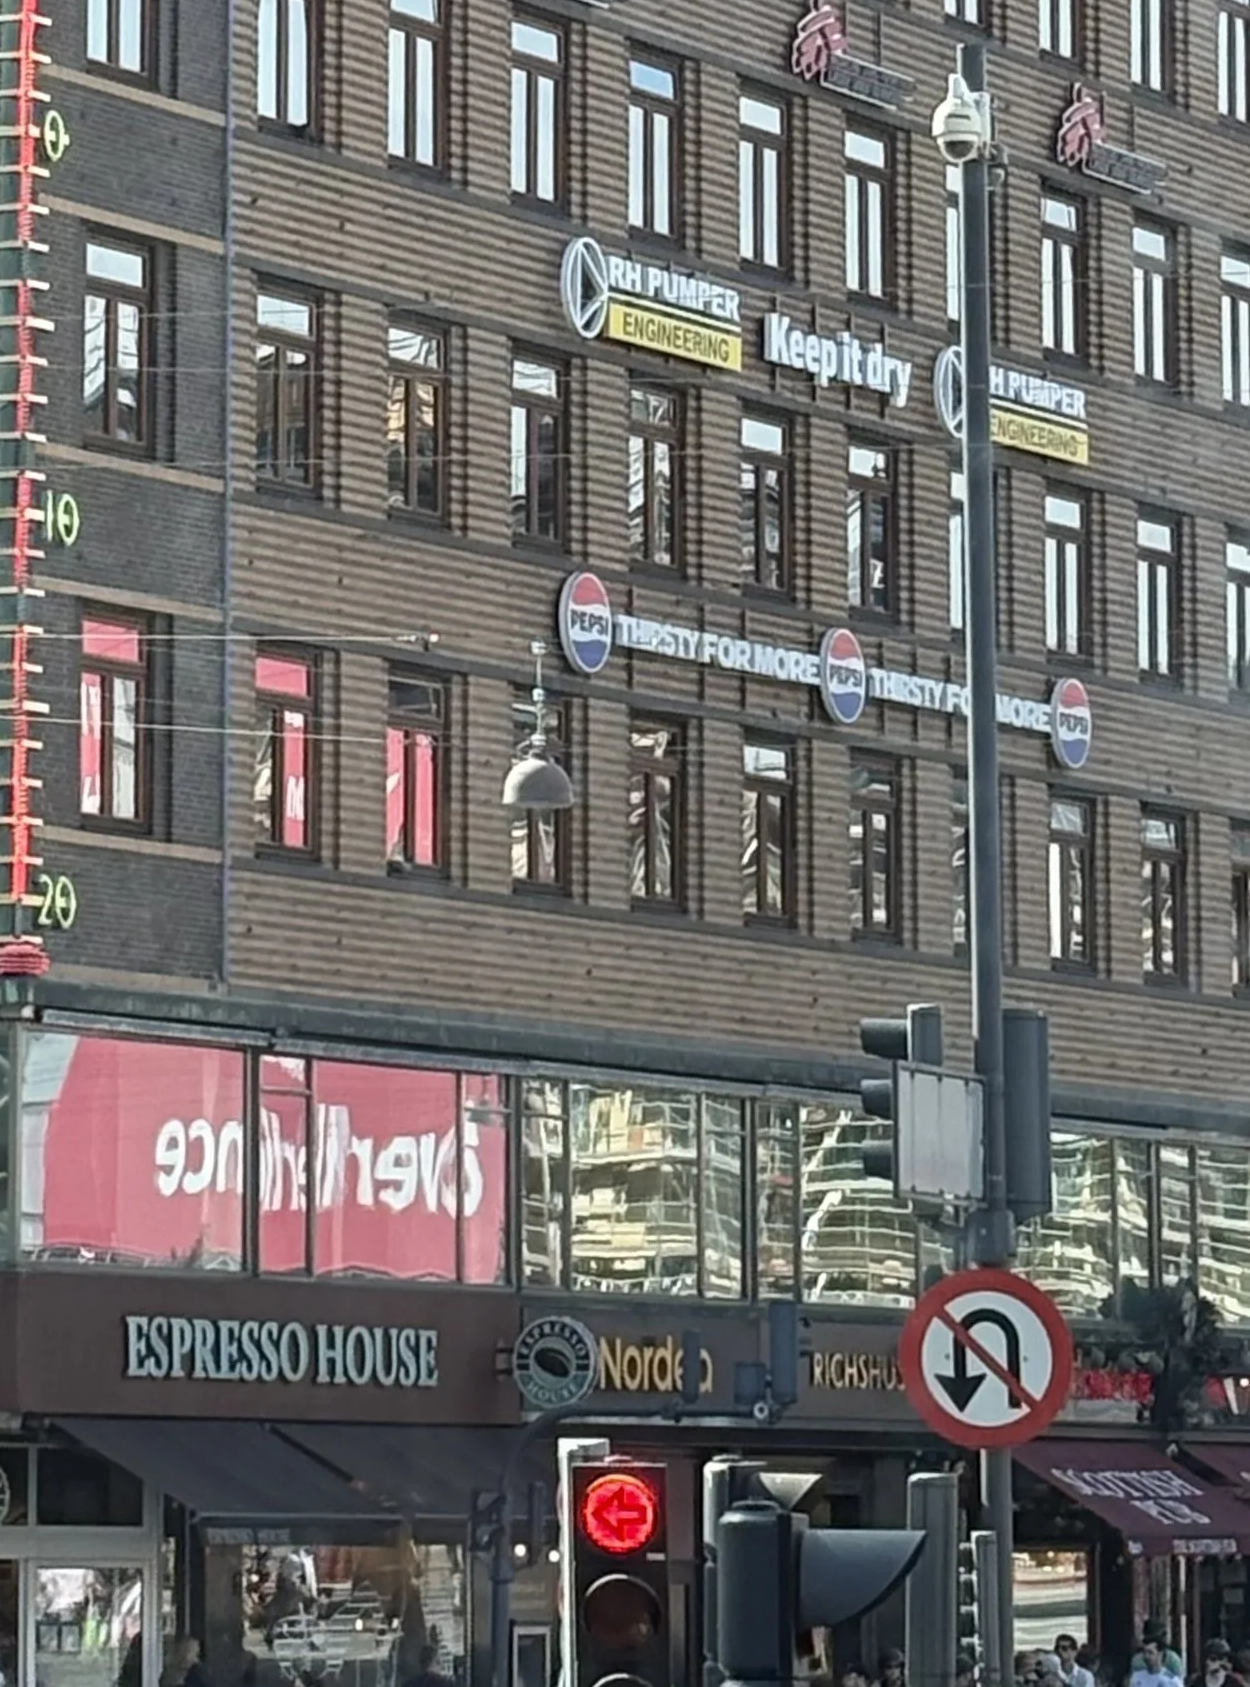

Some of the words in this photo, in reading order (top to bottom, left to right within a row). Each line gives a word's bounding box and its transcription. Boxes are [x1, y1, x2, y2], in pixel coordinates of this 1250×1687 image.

[607, 256, 641, 292] RH
[647, 267, 741, 322] PUMPER
[622, 314, 730, 363] ENGINEERING
[764, 313, 837, 388] Keep
[838, 331, 863, 385] it
[866, 343, 912, 408] dry
[1007, 370, 1087, 419] PUMPER
[46, 489, 80, 546] 10
[570, 608, 610, 637] PEPSI
[616, 614, 699, 660] THIRSTY
[702, 631, 753, 670] FOR
[755, 645, 821, 685] MORE
[829, 664, 862, 688] PEPSI
[870, 667, 942, 712] THIRSTY
[1059, 712, 1089, 736] PEPSI
[38, 873, 77, 929] 20
[125, 1316, 310, 1382] ESPRESSO
[315, 1324, 439, 1386] HOUSE
[1050, 1467, 1204, 1499] SCOTTISH
